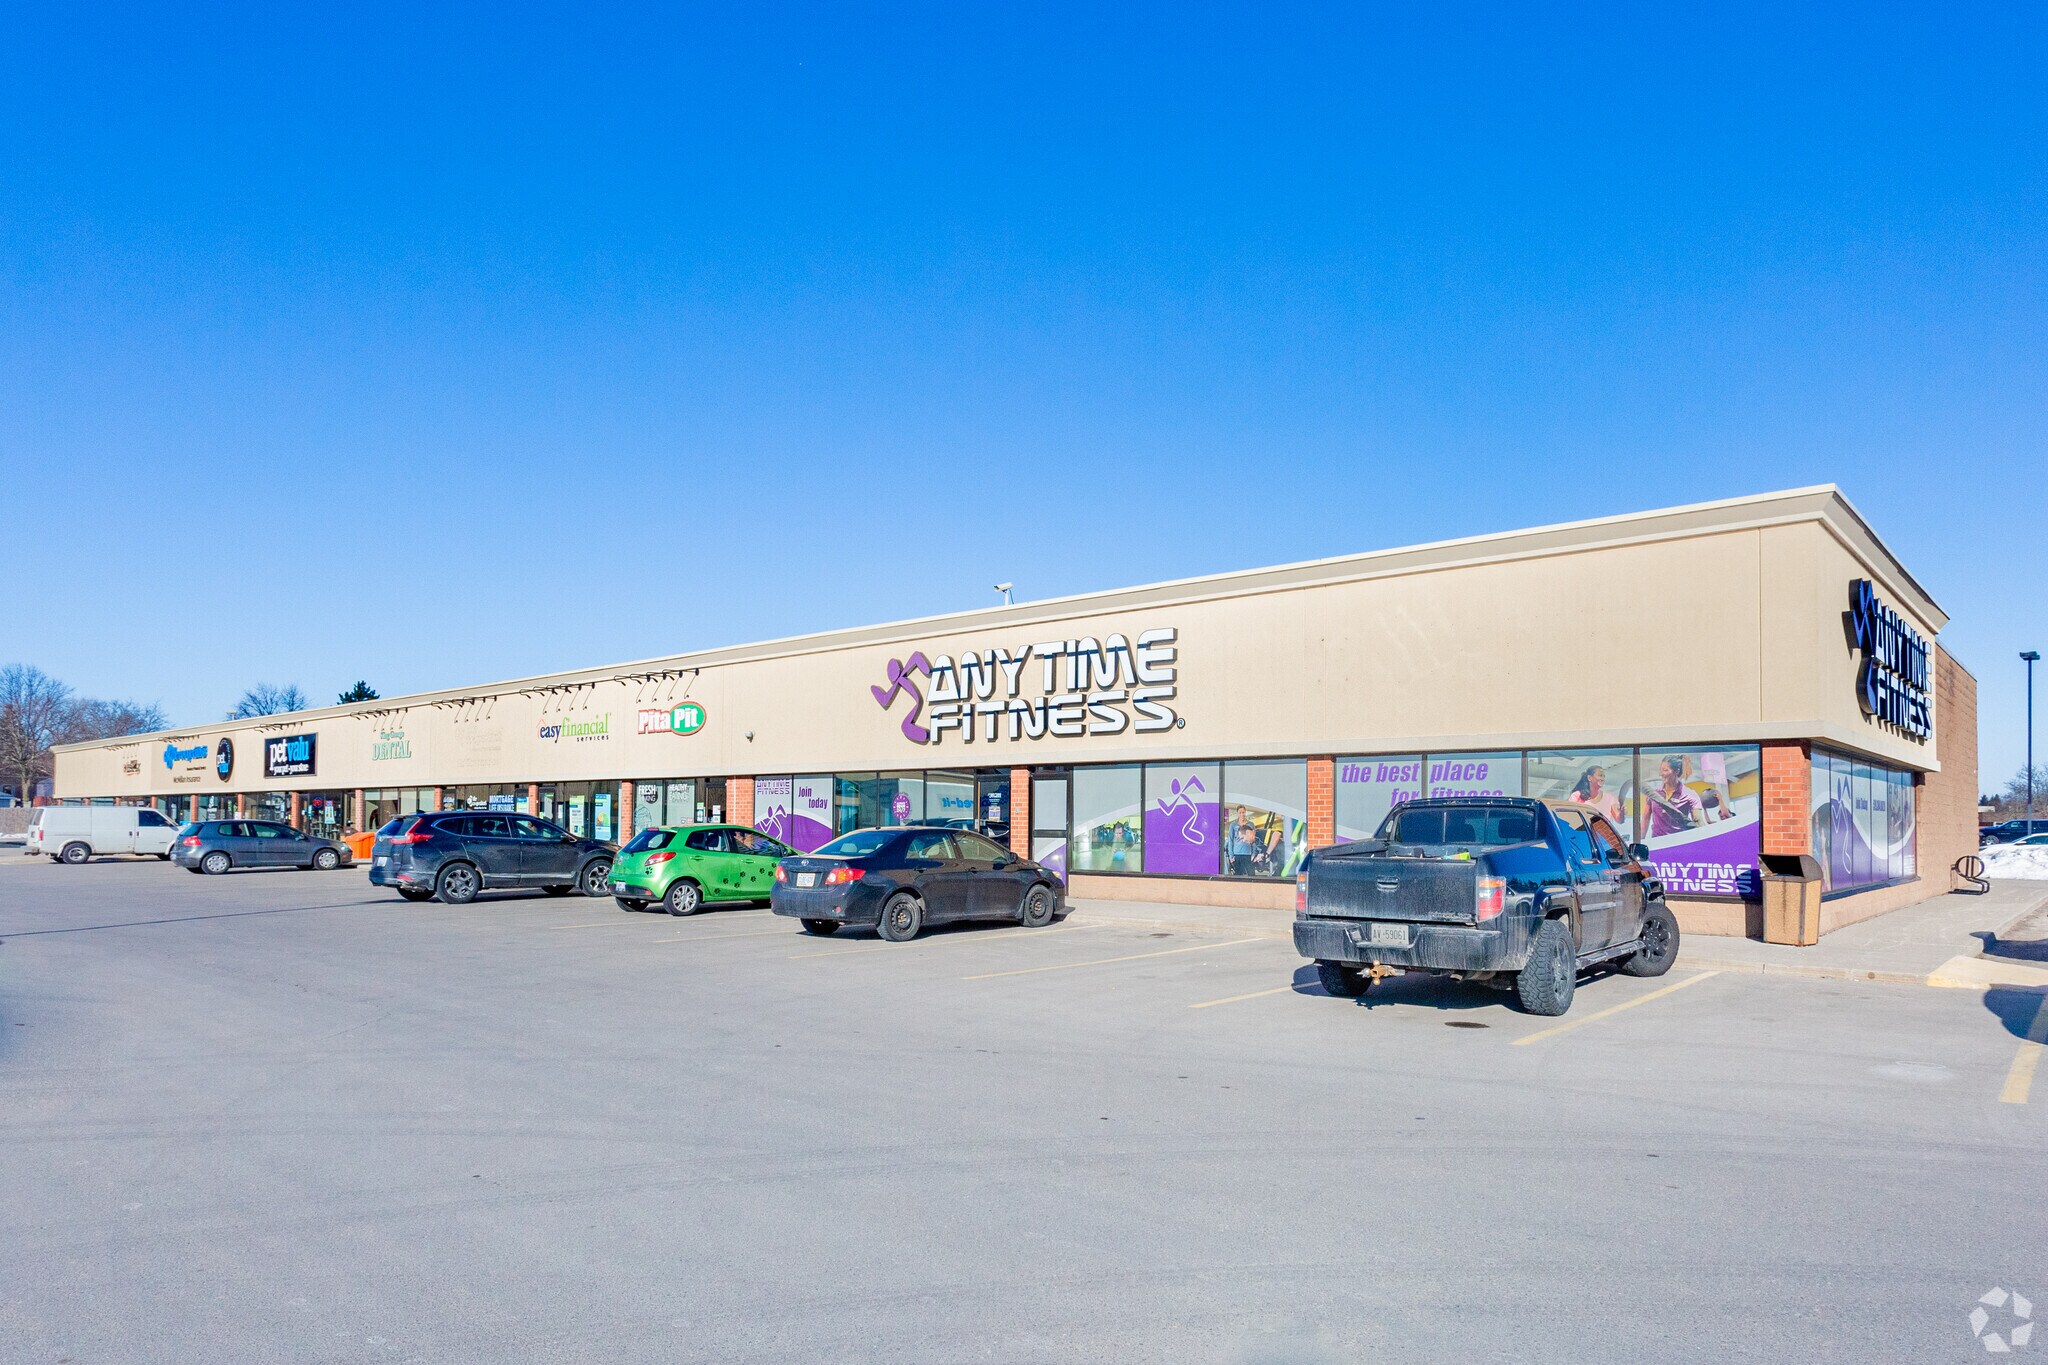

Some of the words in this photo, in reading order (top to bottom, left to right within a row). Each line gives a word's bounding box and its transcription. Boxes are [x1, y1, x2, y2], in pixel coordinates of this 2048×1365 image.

[926, 627, 1177, 702] ANYTIME
[637, 709, 671, 734] Pita
[673, 707, 699, 729] Pit
[929, 686, 1176, 743] FITNESS
[576, 734, 609, 742] services
[372, 740, 412, 761] DENTAL
[1341, 764, 1371, 783] the
[1376, 763, 1420, 783] best
[1429, 761, 1488, 783] place
[638, 784, 656, 795] FRESH
[798, 786, 812, 798] Join
[489, 795, 514, 804] MORTGAGE
[808, 798, 828, 809] today
[1659, 878, 1752, 893] ITNESS
